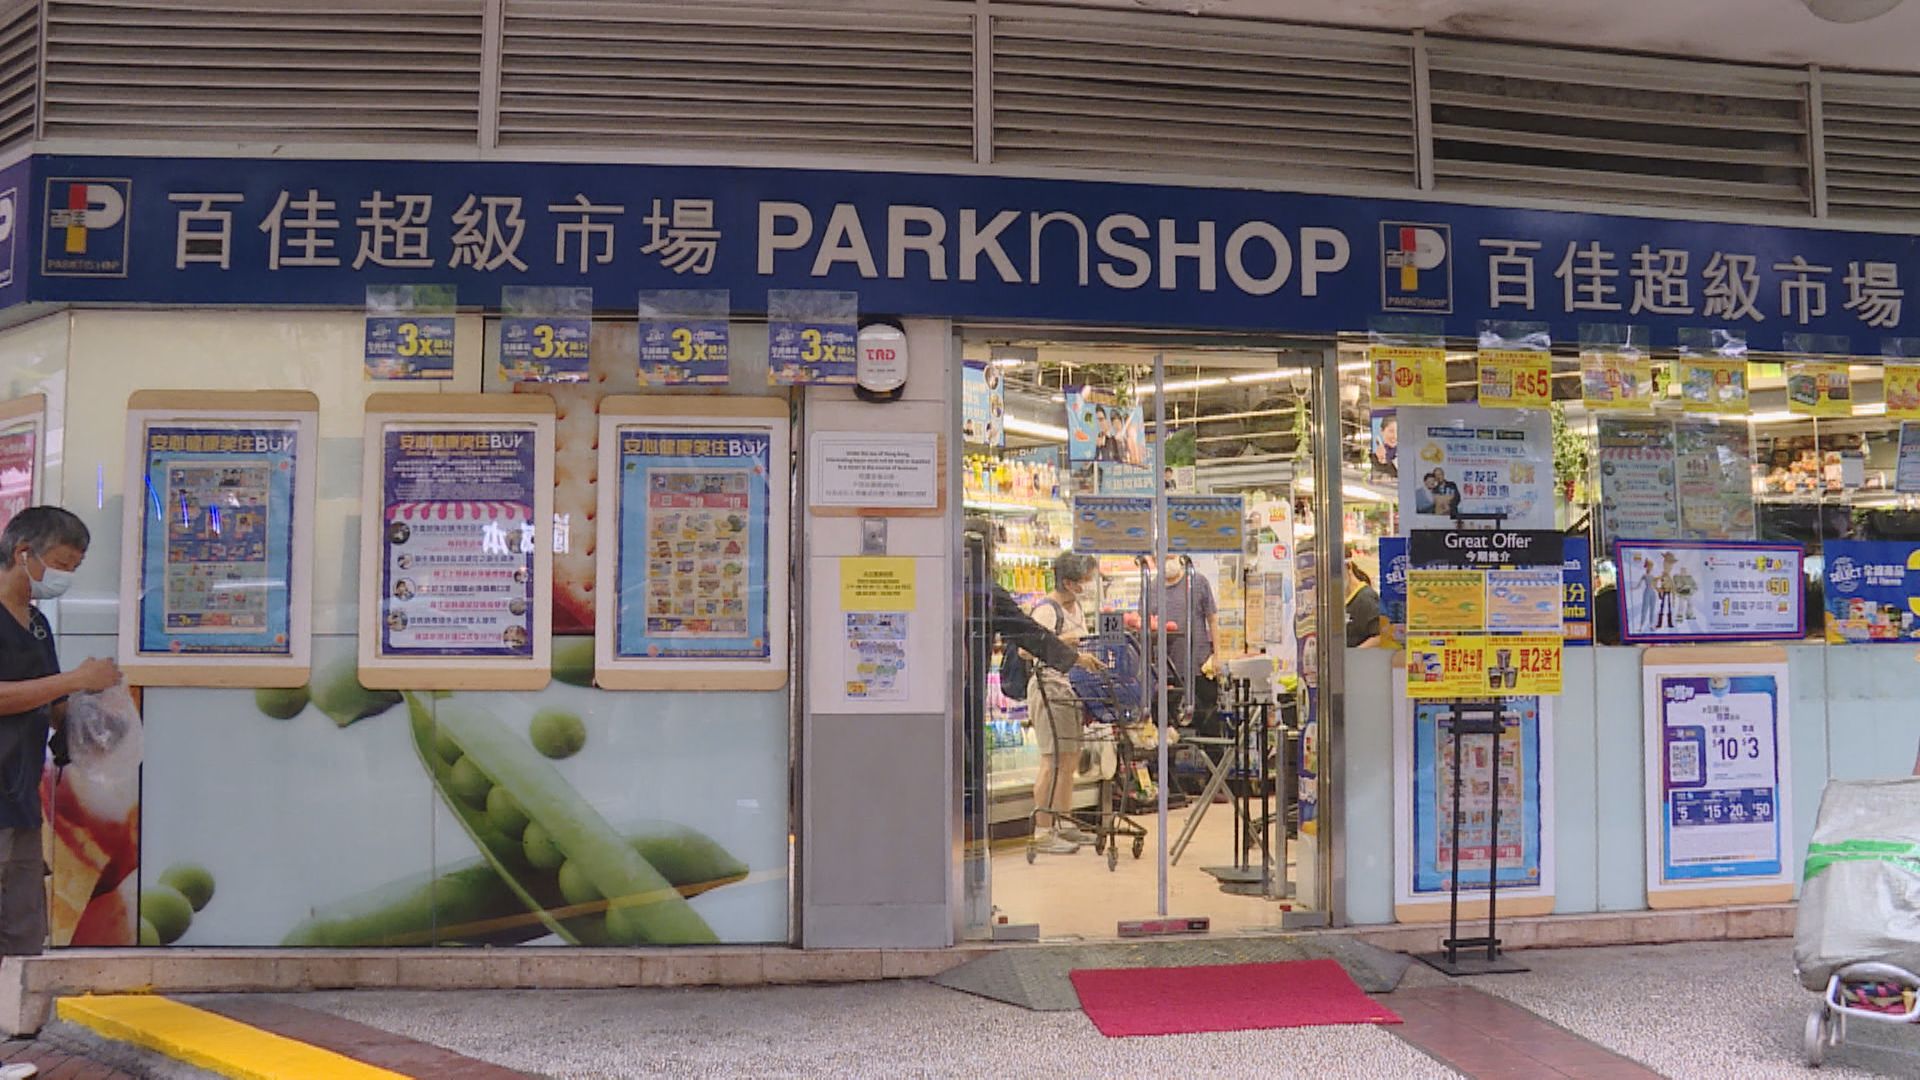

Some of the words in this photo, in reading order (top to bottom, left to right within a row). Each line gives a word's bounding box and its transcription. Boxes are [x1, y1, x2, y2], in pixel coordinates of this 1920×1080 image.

[168, 190, 721, 275] 百佳超級市場
[1479, 238, 1905, 328] 百佳超級市場
[397, 323, 434, 357] 3x
[532, 325, 570, 358] 3x
[672, 329, 708, 361] 3x
[801, 329, 838, 362] 3x
[1445, 533, 1489, 548] Great
[1492, 532, 1533, 548] Offer
[1466, 550, 1511, 562] 今期推介
